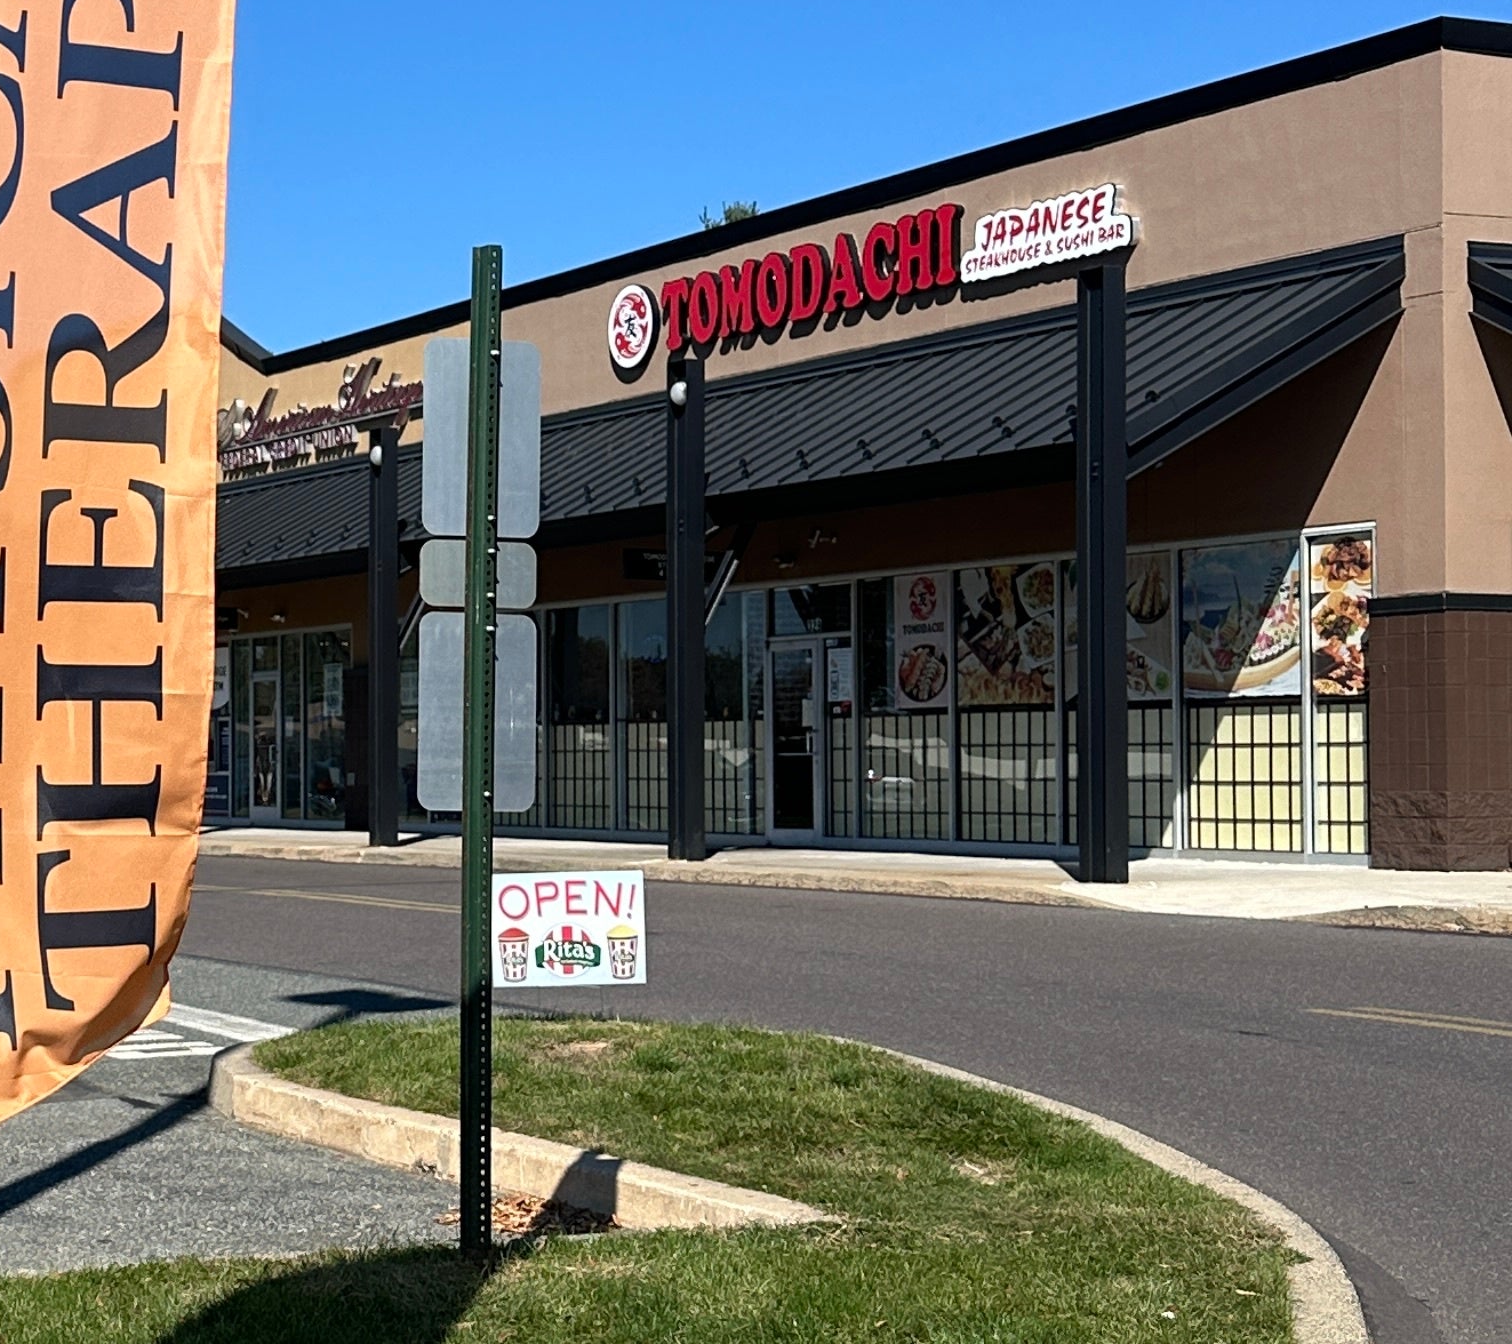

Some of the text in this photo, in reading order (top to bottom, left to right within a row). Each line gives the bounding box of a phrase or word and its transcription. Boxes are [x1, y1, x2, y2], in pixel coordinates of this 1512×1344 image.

[981, 191, 1107, 252] JAPANESE
[965, 223, 1125, 275] STEAKHOUSE & SUSHI BAR
[661, 203, 958, 351] TOMODACHI
[498, 880, 637, 921] OPEN!
[543, 939, 596, 962] Rita's
